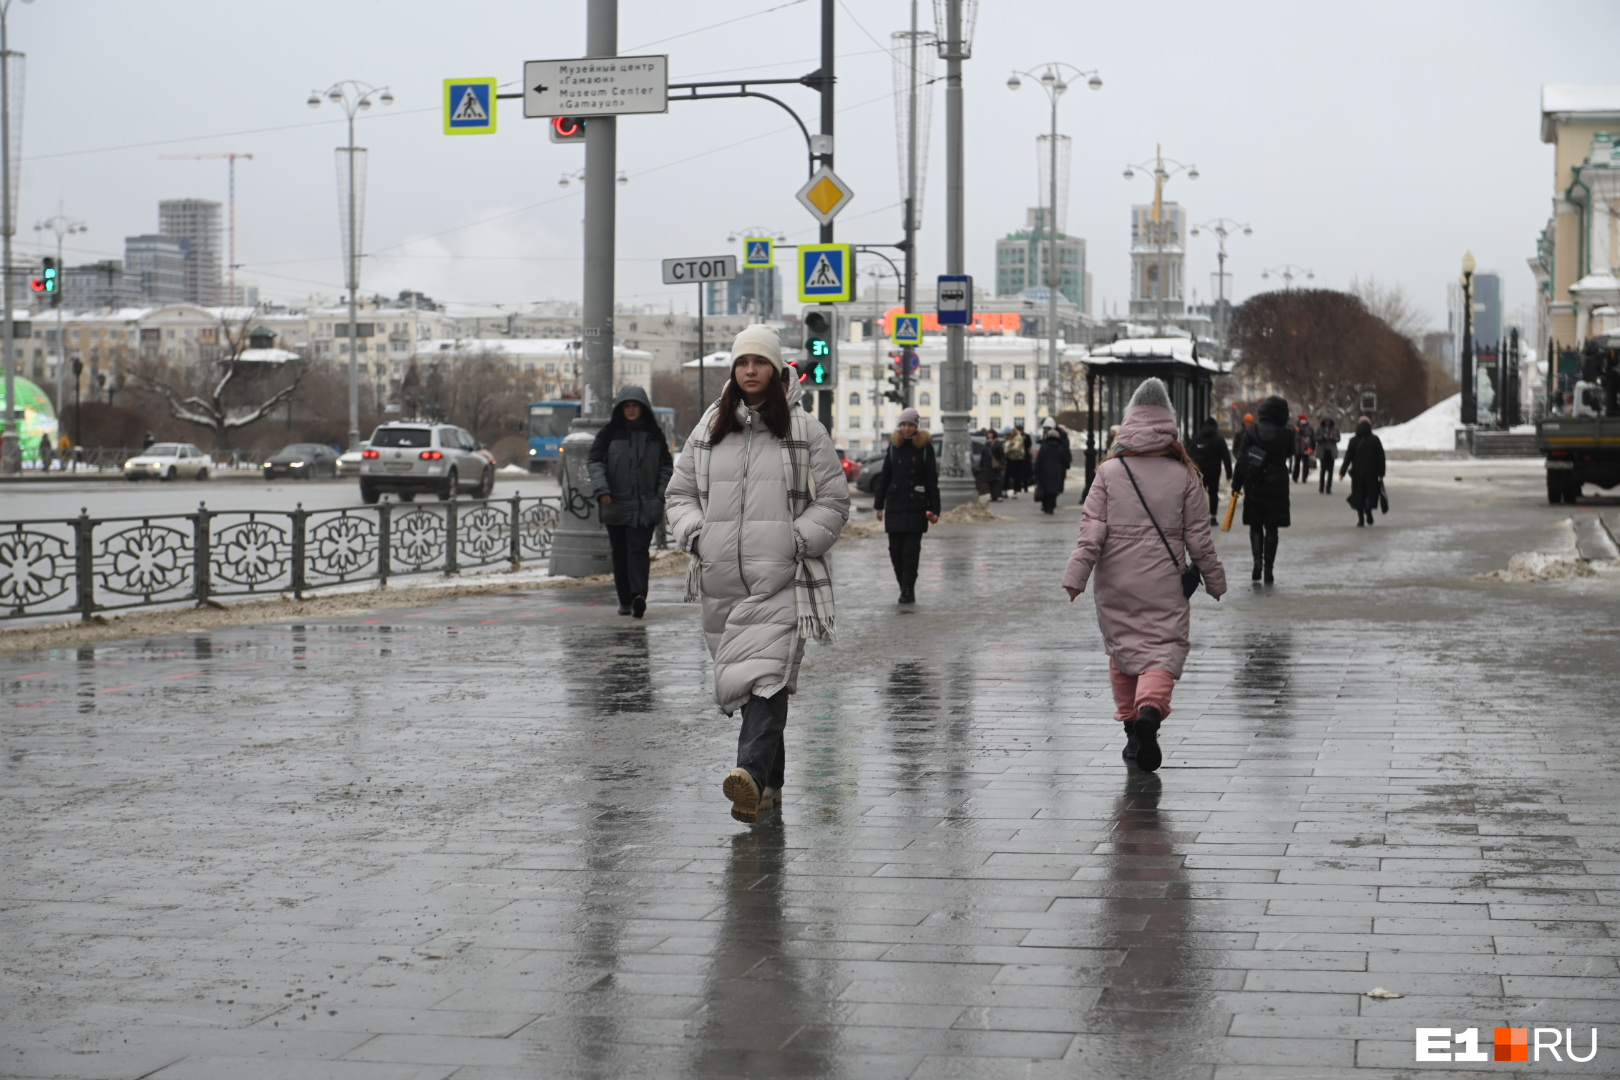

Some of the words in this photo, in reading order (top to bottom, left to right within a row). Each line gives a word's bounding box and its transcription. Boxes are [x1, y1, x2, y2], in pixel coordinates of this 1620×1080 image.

[559, 63, 616, 75] Музейный
[620, 63, 655, 73] центр
[559, 76, 615, 85] «Гамаюн»
[559, 88, 607, 97] Museum
[611, 86, 654, 96] Center
[559, 99, 625, 109] «Gamayun»
[672, 260, 726, 279] СТОП
